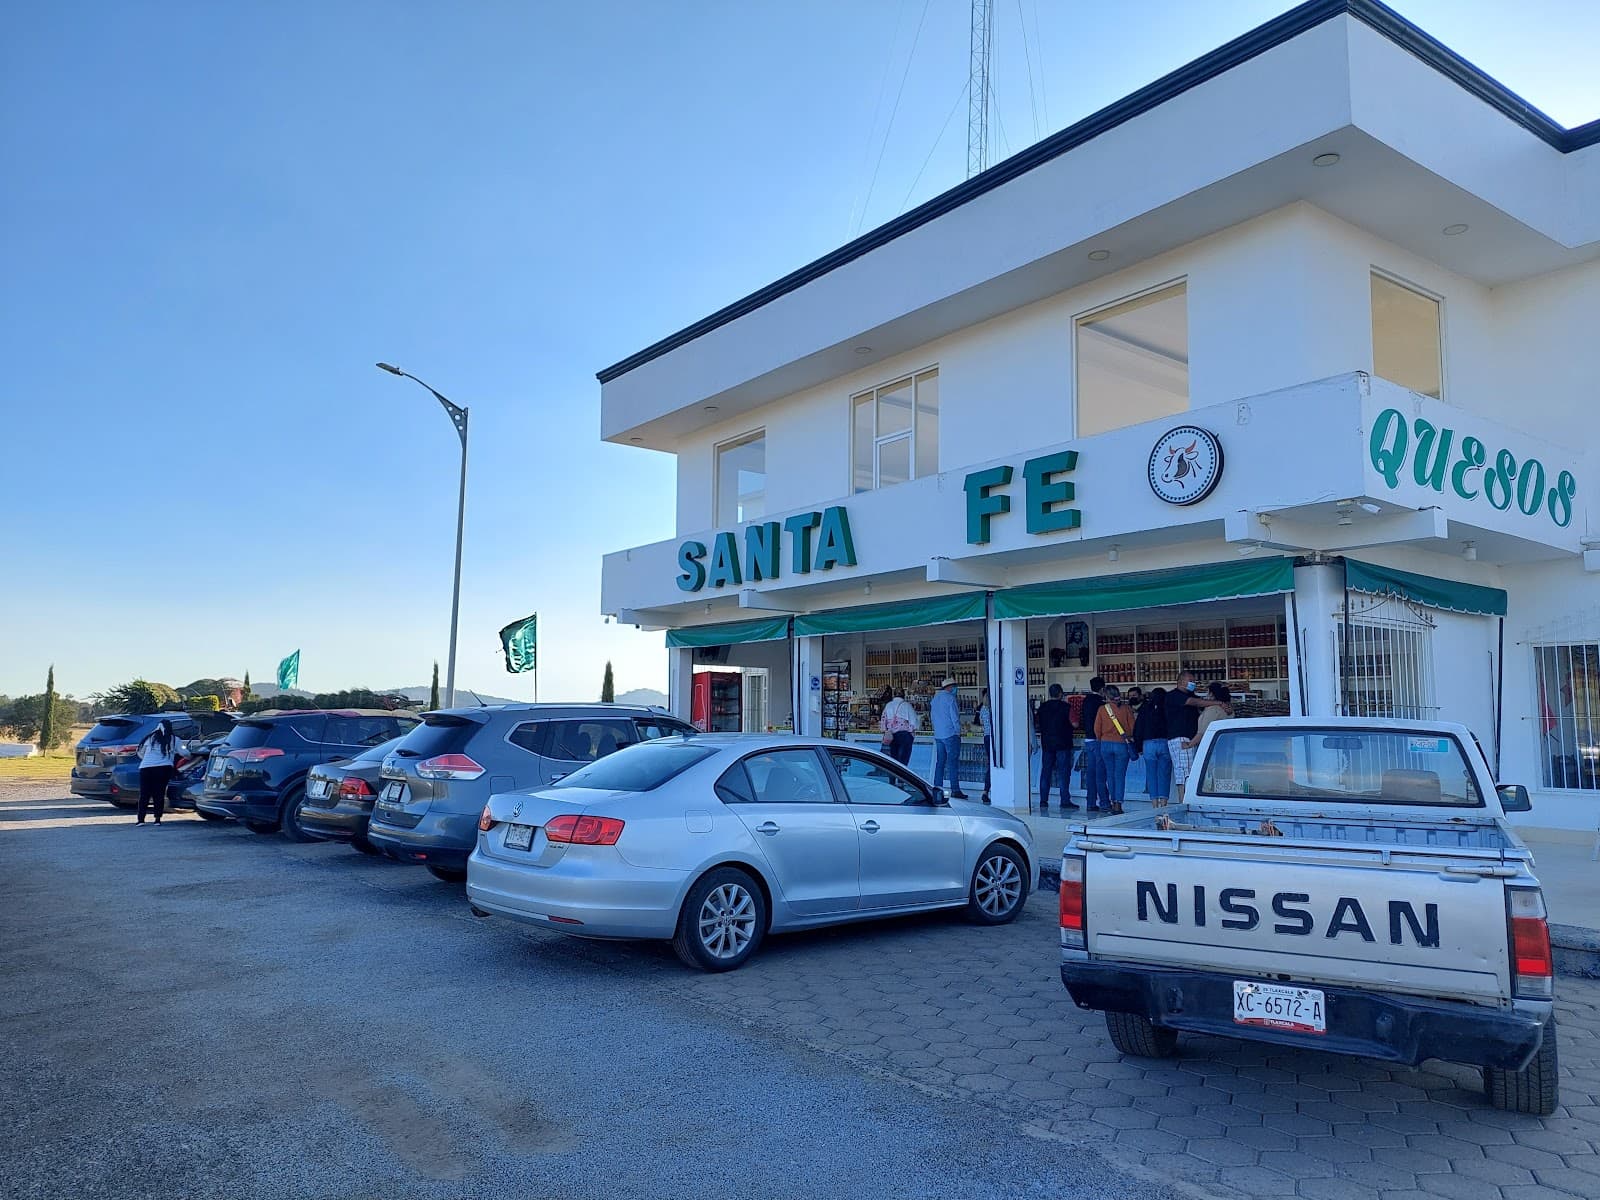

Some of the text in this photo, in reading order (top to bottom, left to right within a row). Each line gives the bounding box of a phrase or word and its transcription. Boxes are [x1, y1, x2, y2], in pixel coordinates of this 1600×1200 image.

[1369, 408, 1577, 528] QUESOS
[676, 450, 1082, 592] SANTA FE
[1136, 880, 1441, 948] NISSAN
[1237, 991, 1322, 1020] XC-6572-A
